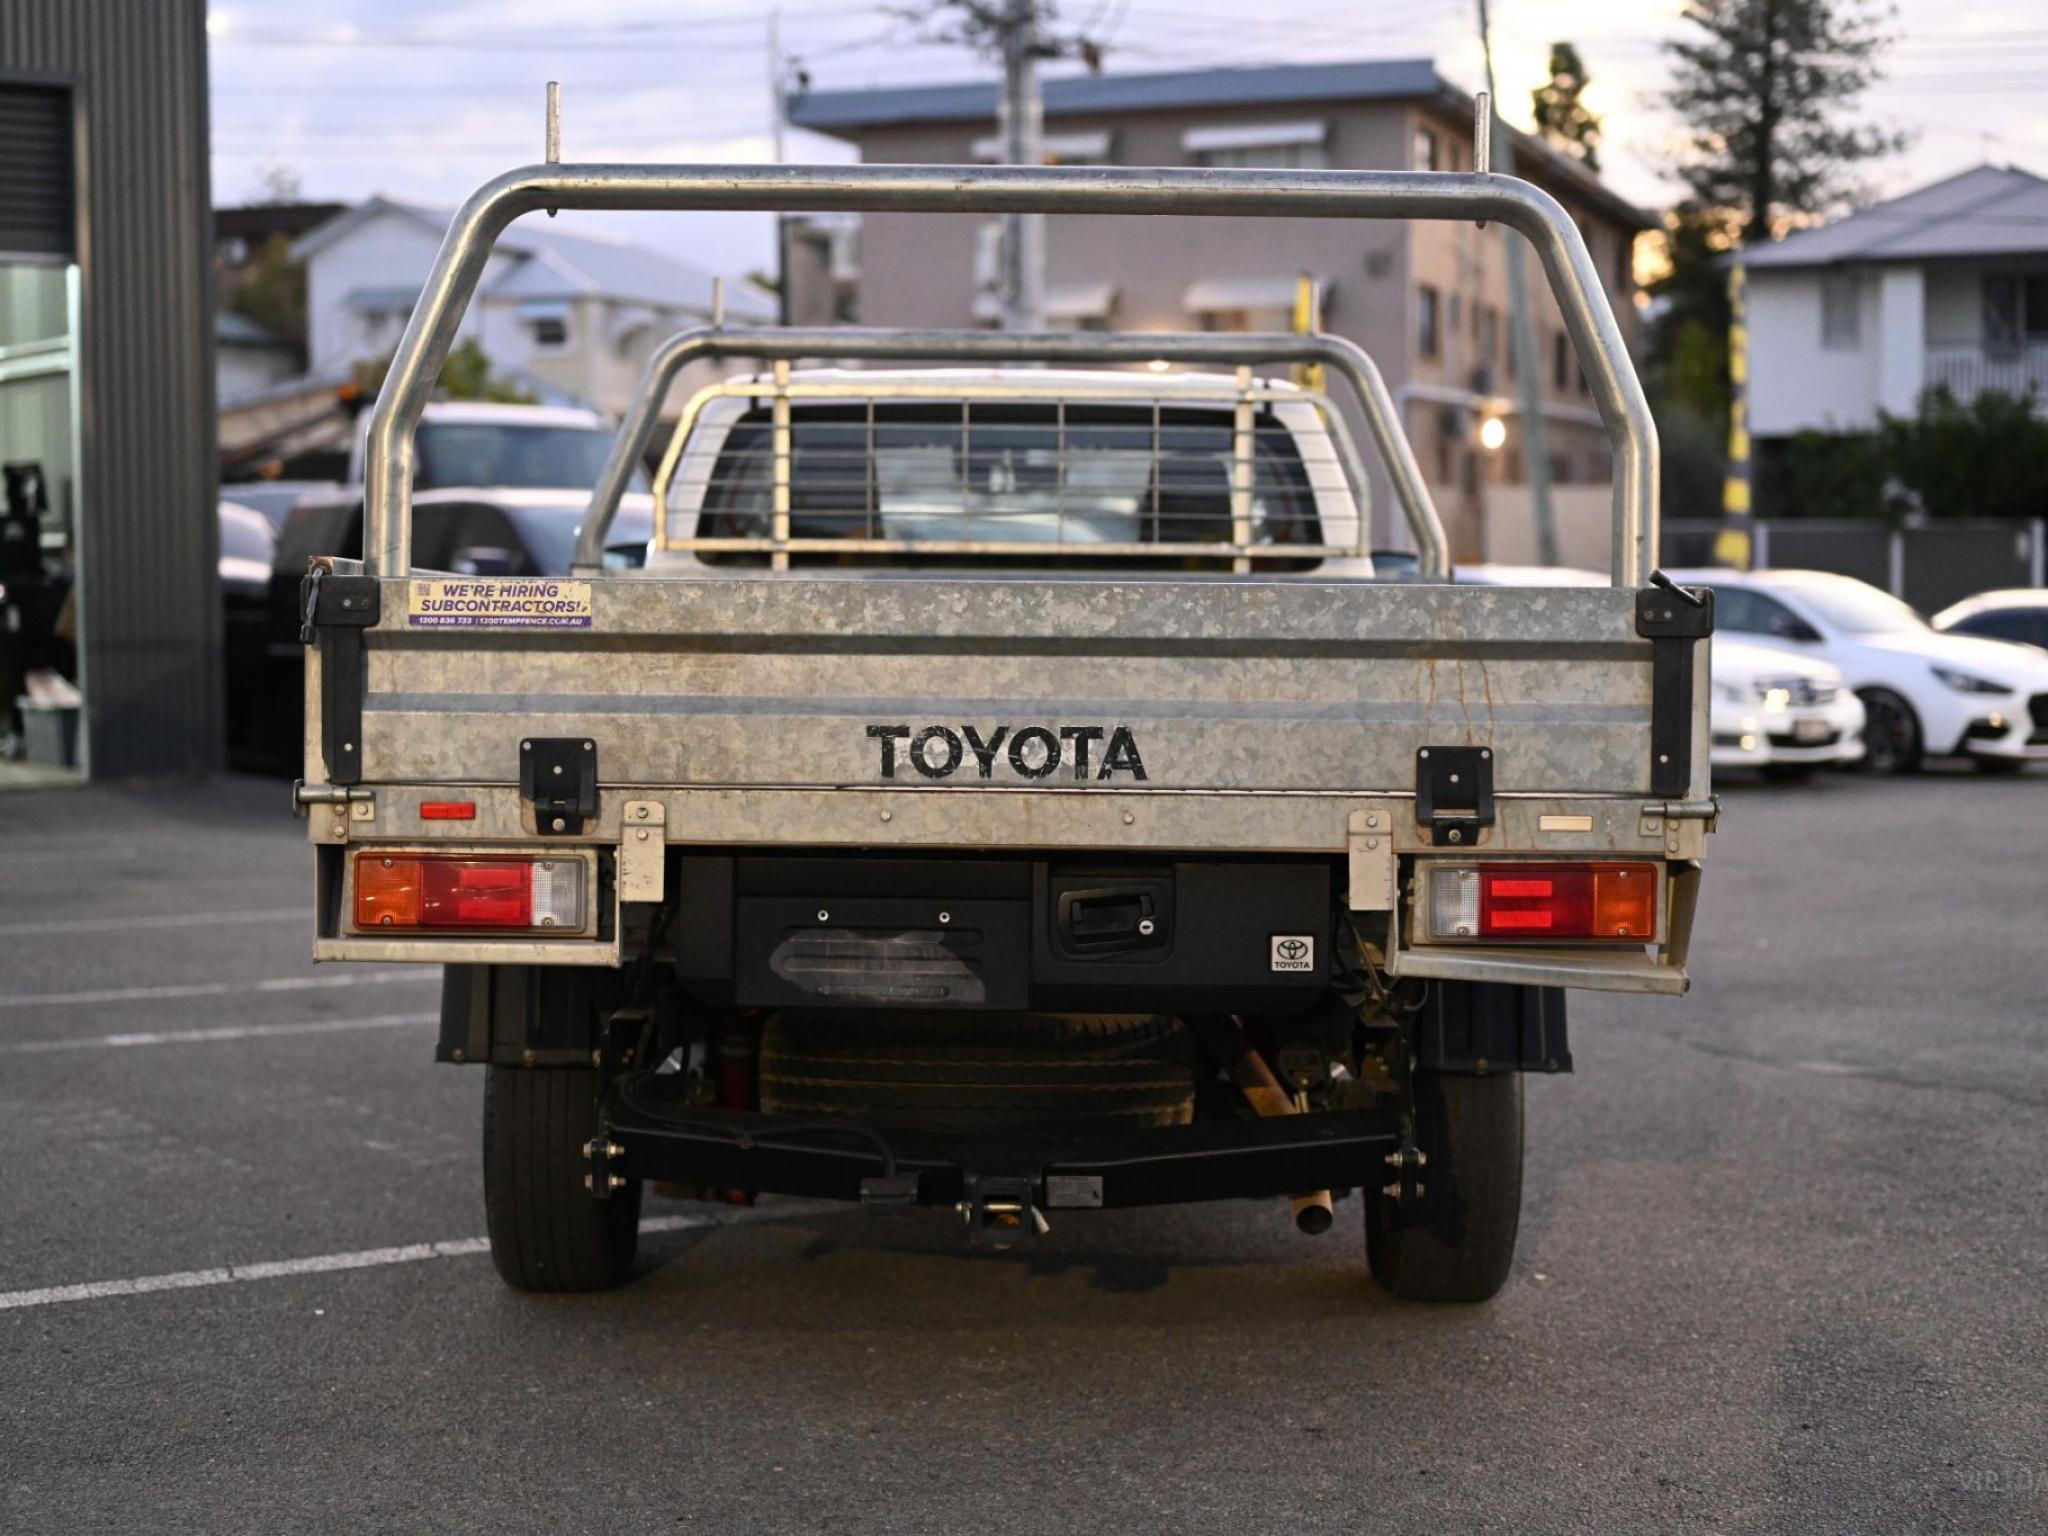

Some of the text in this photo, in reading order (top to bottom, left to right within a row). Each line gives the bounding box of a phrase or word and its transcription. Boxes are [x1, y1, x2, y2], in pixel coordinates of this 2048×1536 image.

[443, 584, 559, 598] WE'RE HIRING
[420, 599, 581, 613] SUBCONTRACTORS!
[866, 724, 1149, 781] TOYOTA
[1275, 961, 1310, 969] TOYOTA
